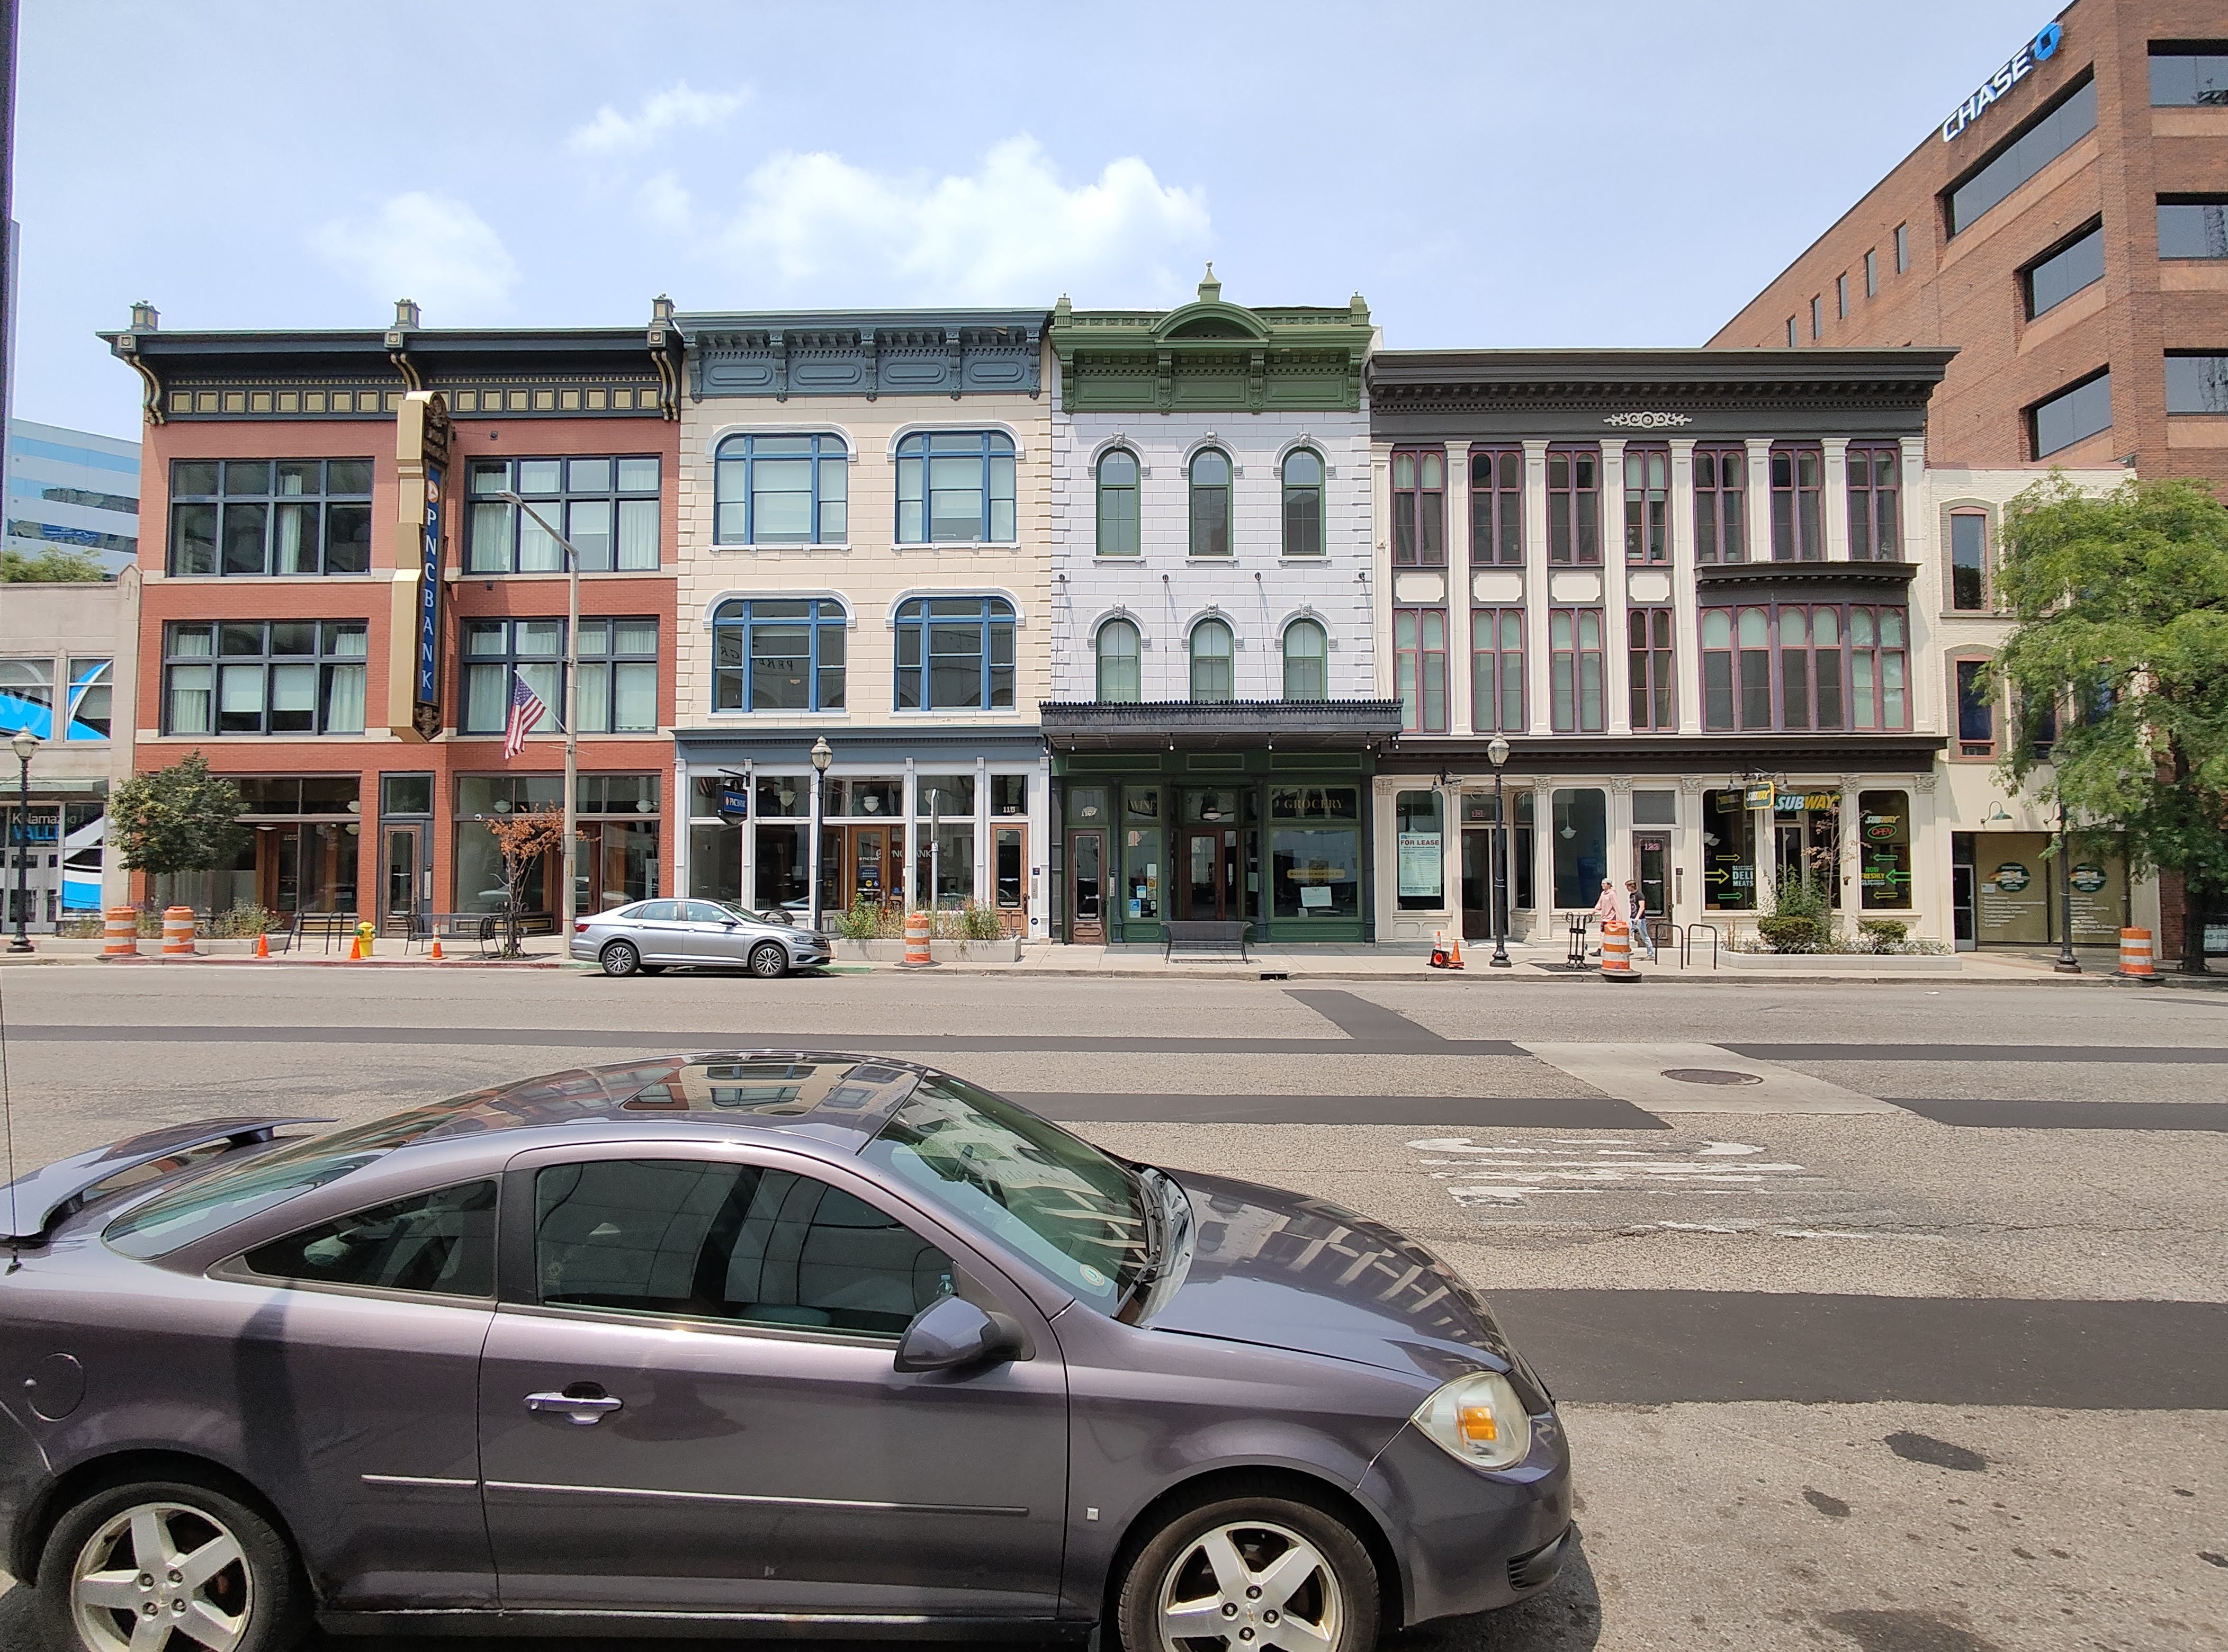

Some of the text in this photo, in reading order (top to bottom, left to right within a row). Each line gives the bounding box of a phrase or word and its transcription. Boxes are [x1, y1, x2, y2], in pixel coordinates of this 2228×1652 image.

[1943, 46, 2033, 142] CHASE
[1747, 790, 1770, 801] SUBWAY
[1129, 800, 1156, 810] WINE
[1284, 800, 1343, 809] GROCERY
[1775, 795, 1841, 811] SUBWAY
[1865, 815, 1901, 824] SUBWAY
[1732, 871, 1754, 879] DELI
